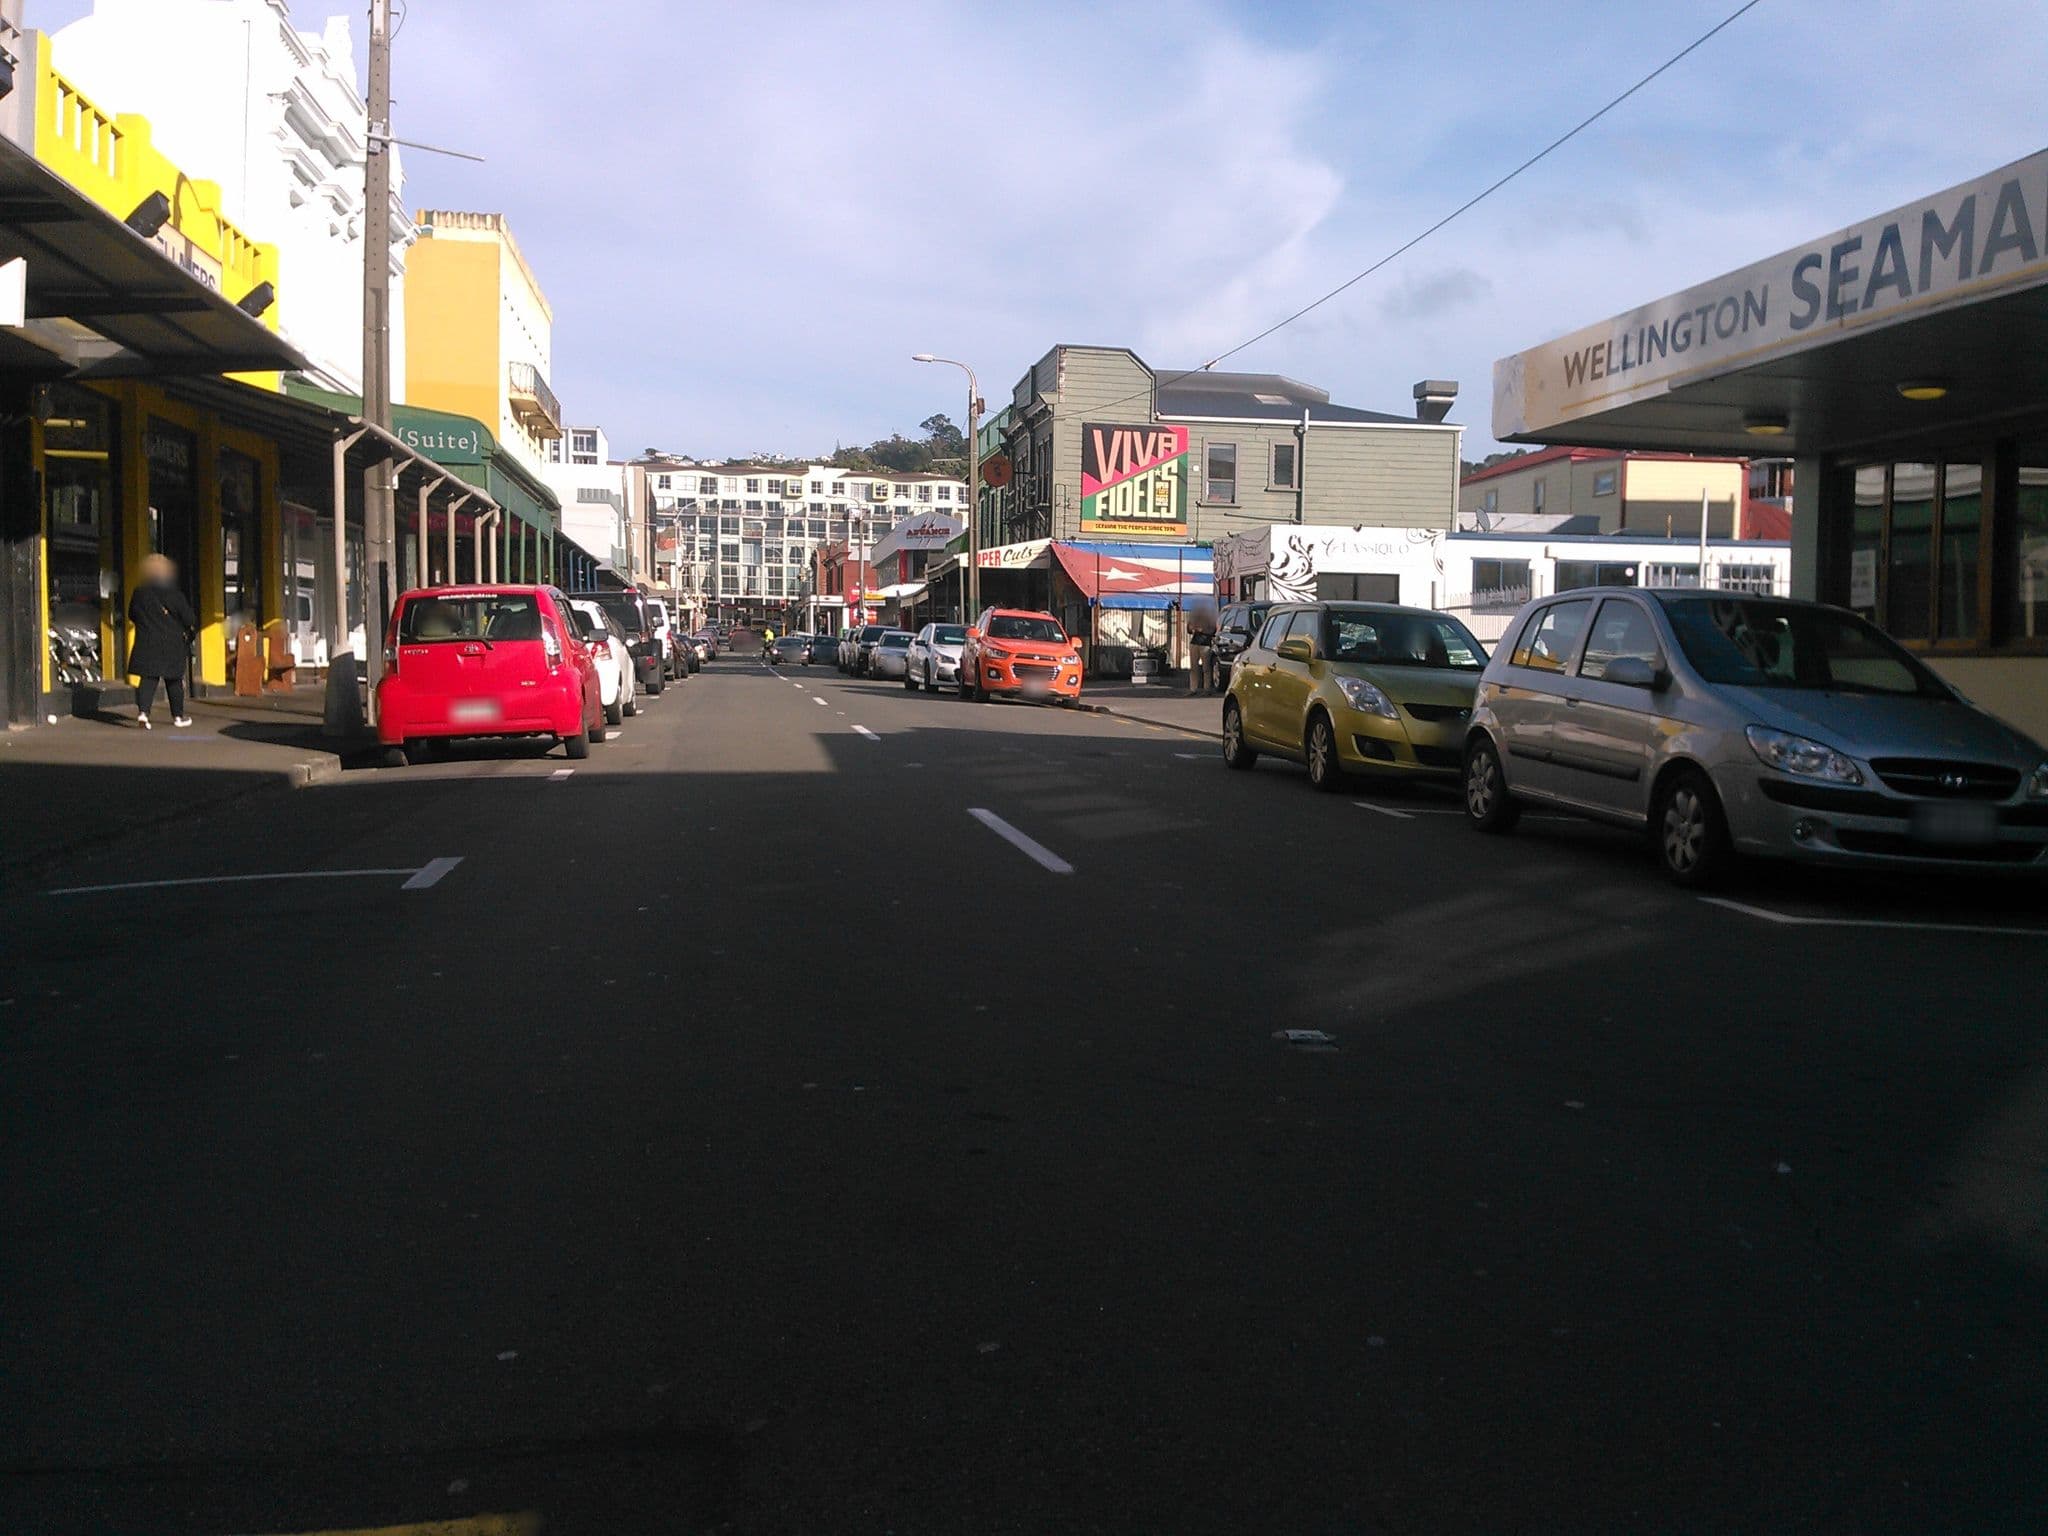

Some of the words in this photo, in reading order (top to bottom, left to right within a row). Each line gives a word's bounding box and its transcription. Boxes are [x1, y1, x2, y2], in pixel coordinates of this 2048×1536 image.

[1563, 284, 1769, 389] WELLINGTON
[1789, 177, 2048, 330] SEAMA
[1093, 429, 1178, 485] VIVA
[1128, 524, 1148, 532] PEOPLE
[975, 549, 1001, 567] UPER
[1002, 546, 1033, 562] Cuts
